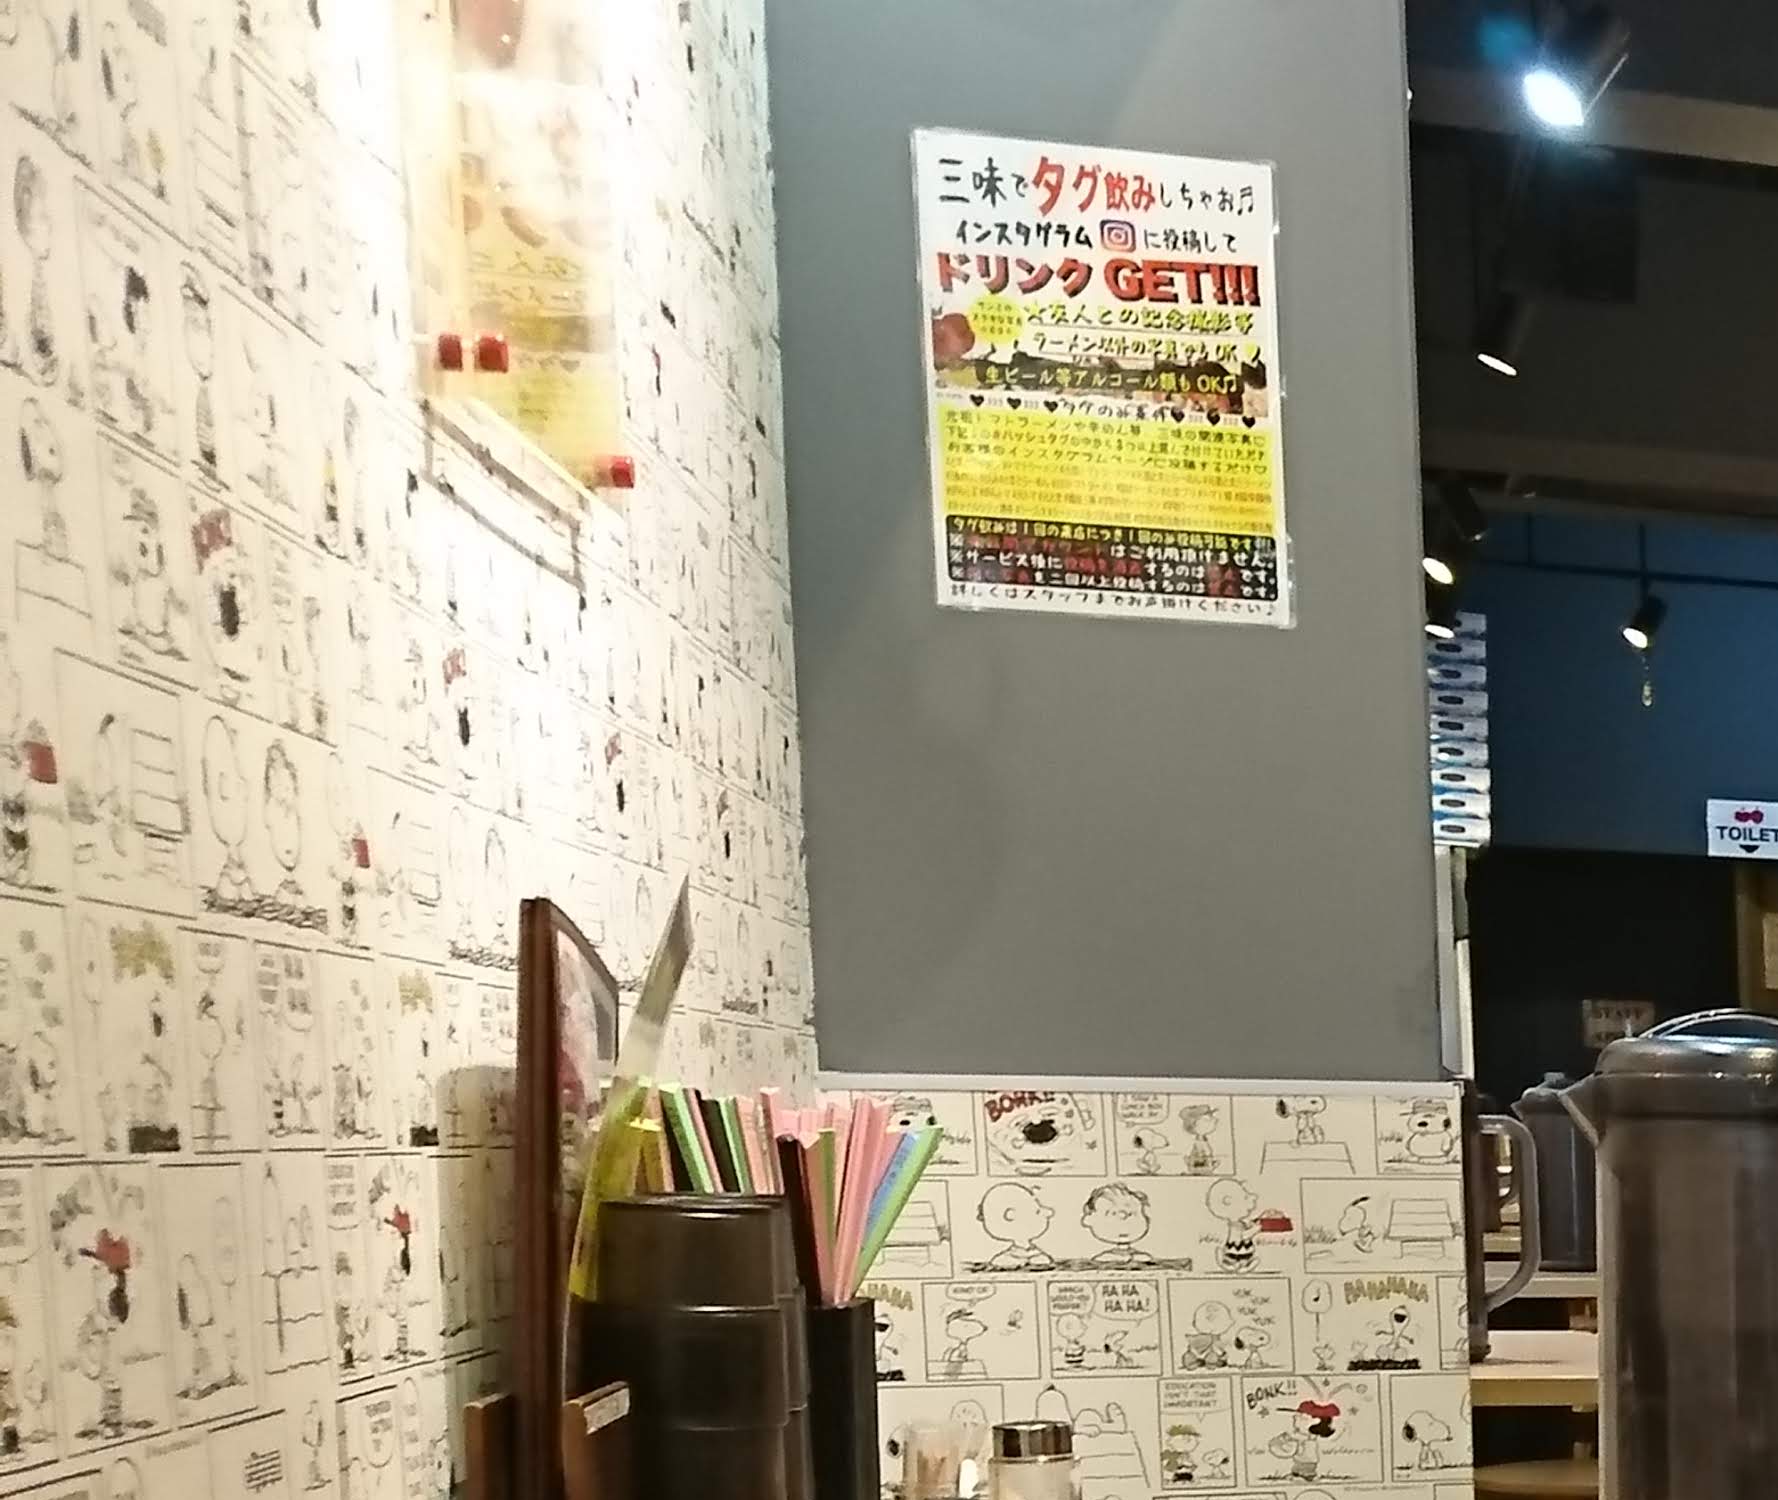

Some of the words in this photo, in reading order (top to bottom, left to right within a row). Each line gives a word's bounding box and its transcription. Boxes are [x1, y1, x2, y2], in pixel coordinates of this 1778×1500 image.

[956, 220, 1092, 249] インスタグラム
[1144, 231, 1237, 253] に投稿して
[937, 252, 1093, 298] ドリンク
[1104, 257, 1261, 307] GET!!!
[1102, 1284, 1120, 1297] HA
[1122, 1284, 1139, 1297] HA
[1104, 1299, 1124, 1312] HA
[1246, 1380, 1298, 1411] BONK!!
